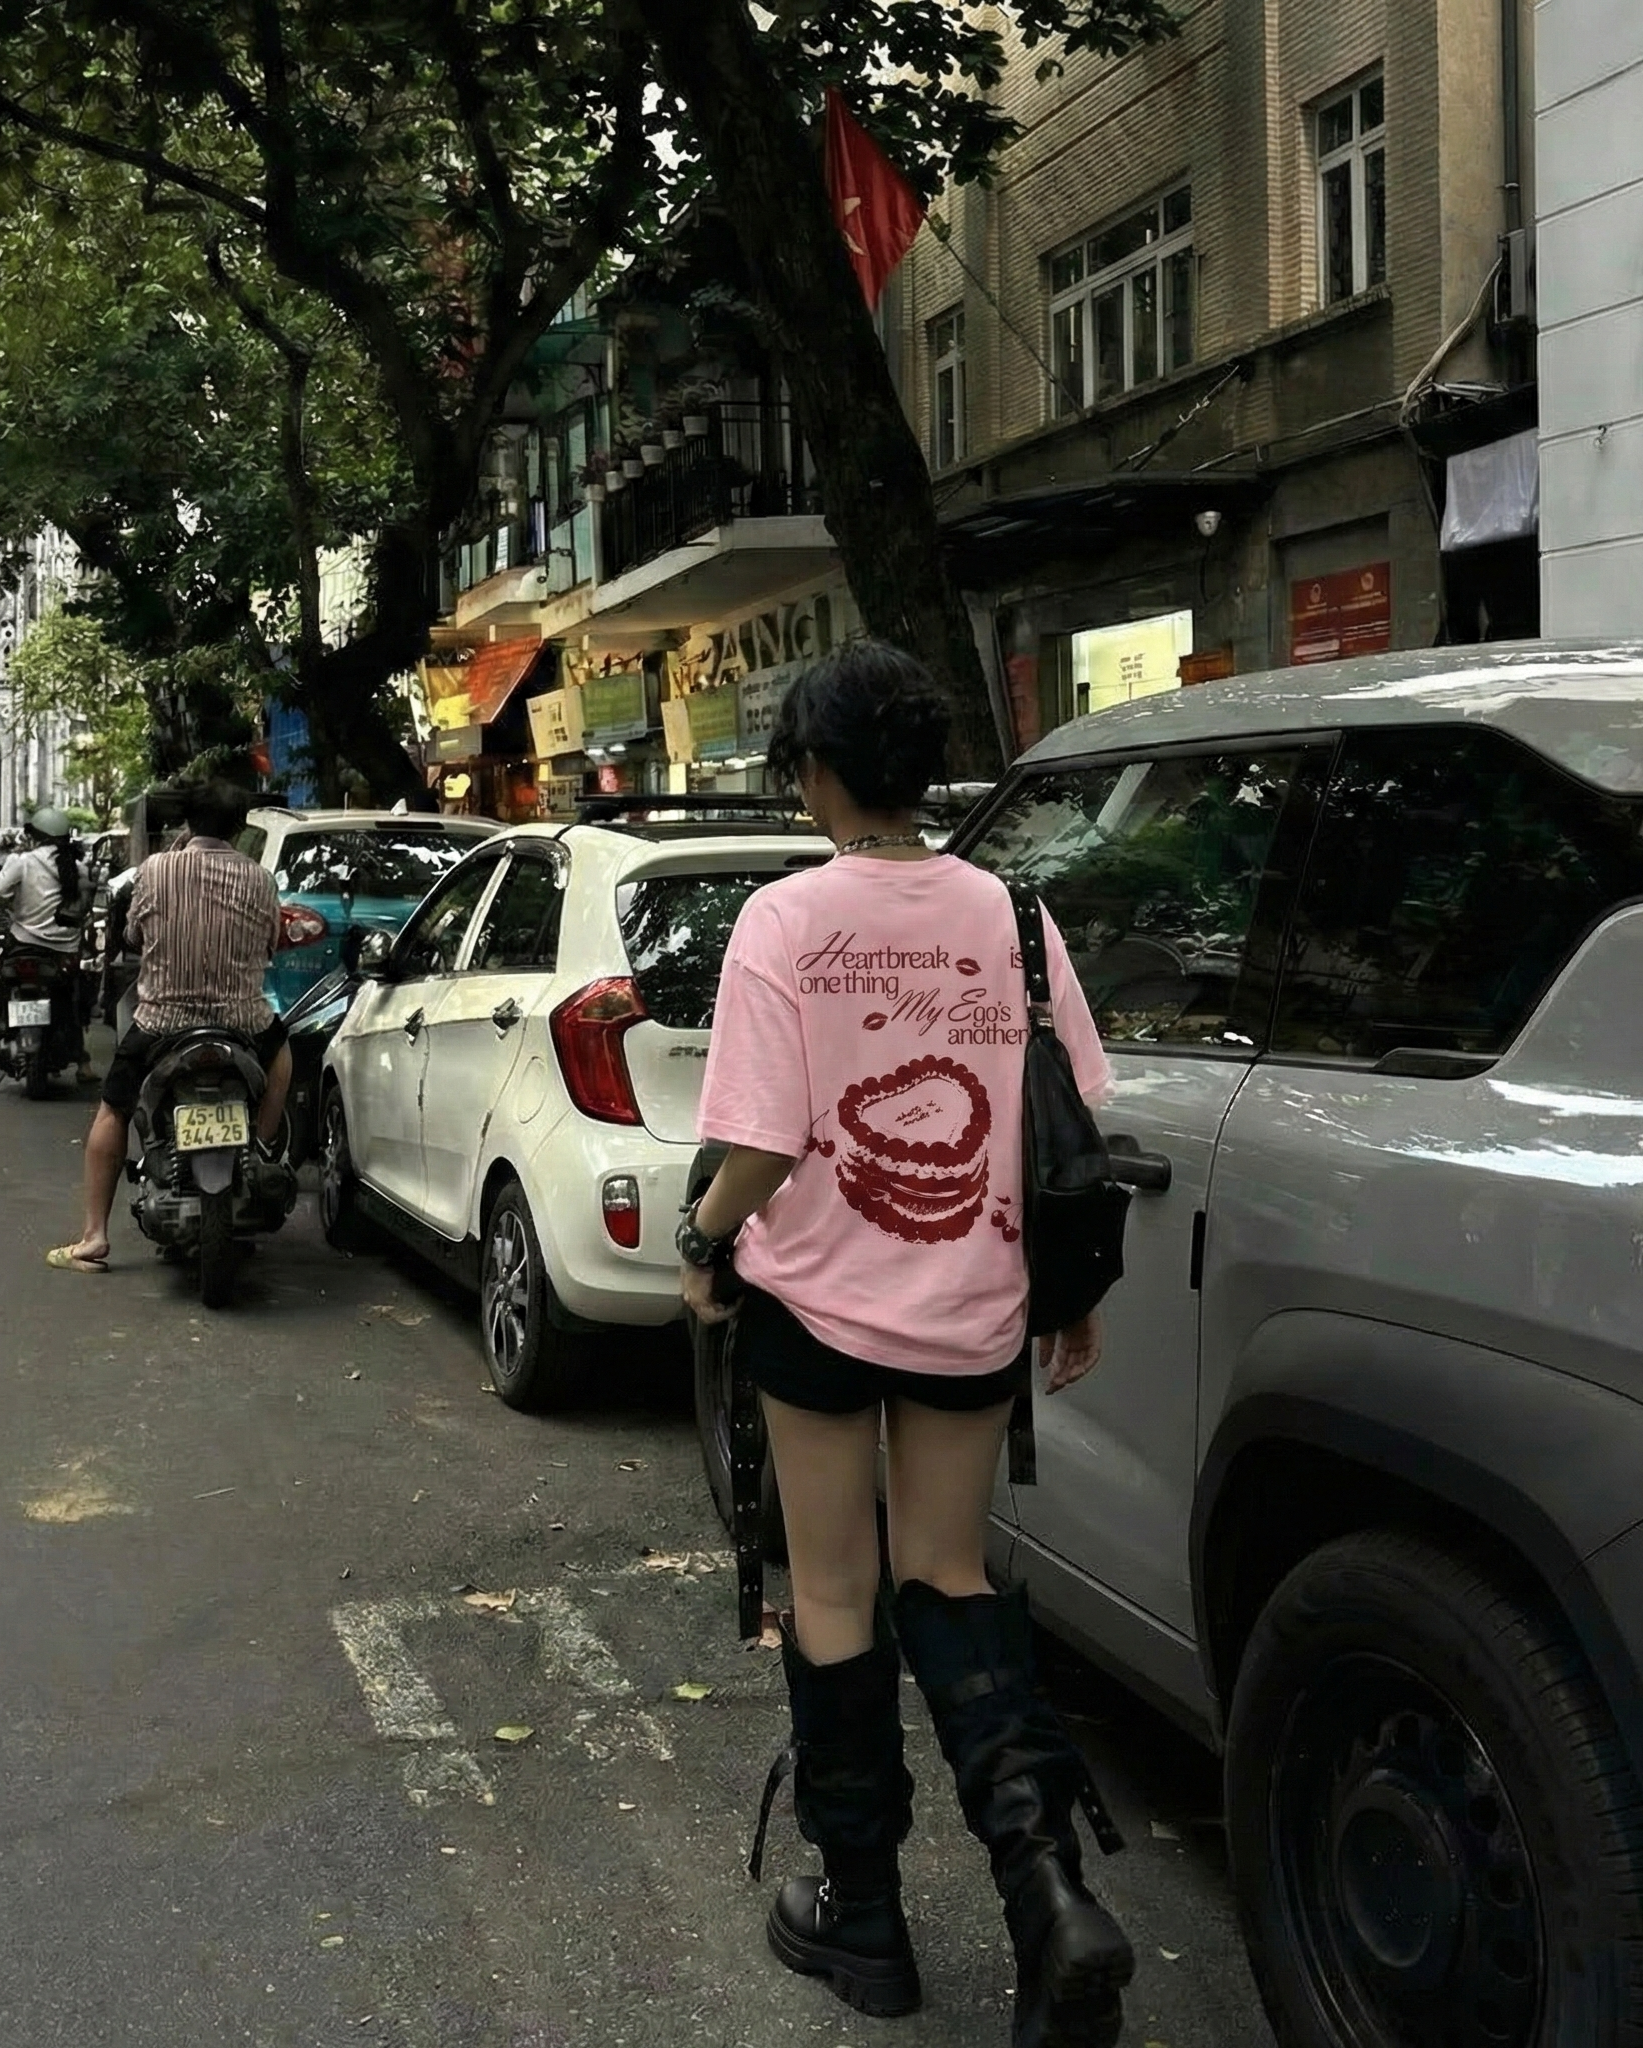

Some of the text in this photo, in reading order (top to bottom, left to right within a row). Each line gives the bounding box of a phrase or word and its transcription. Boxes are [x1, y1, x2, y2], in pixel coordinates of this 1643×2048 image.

[796, 930, 1025, 971] Heartbreak is
[890, 987, 1011, 1037] My Ego's
[947, 1022, 1029, 1045] another
